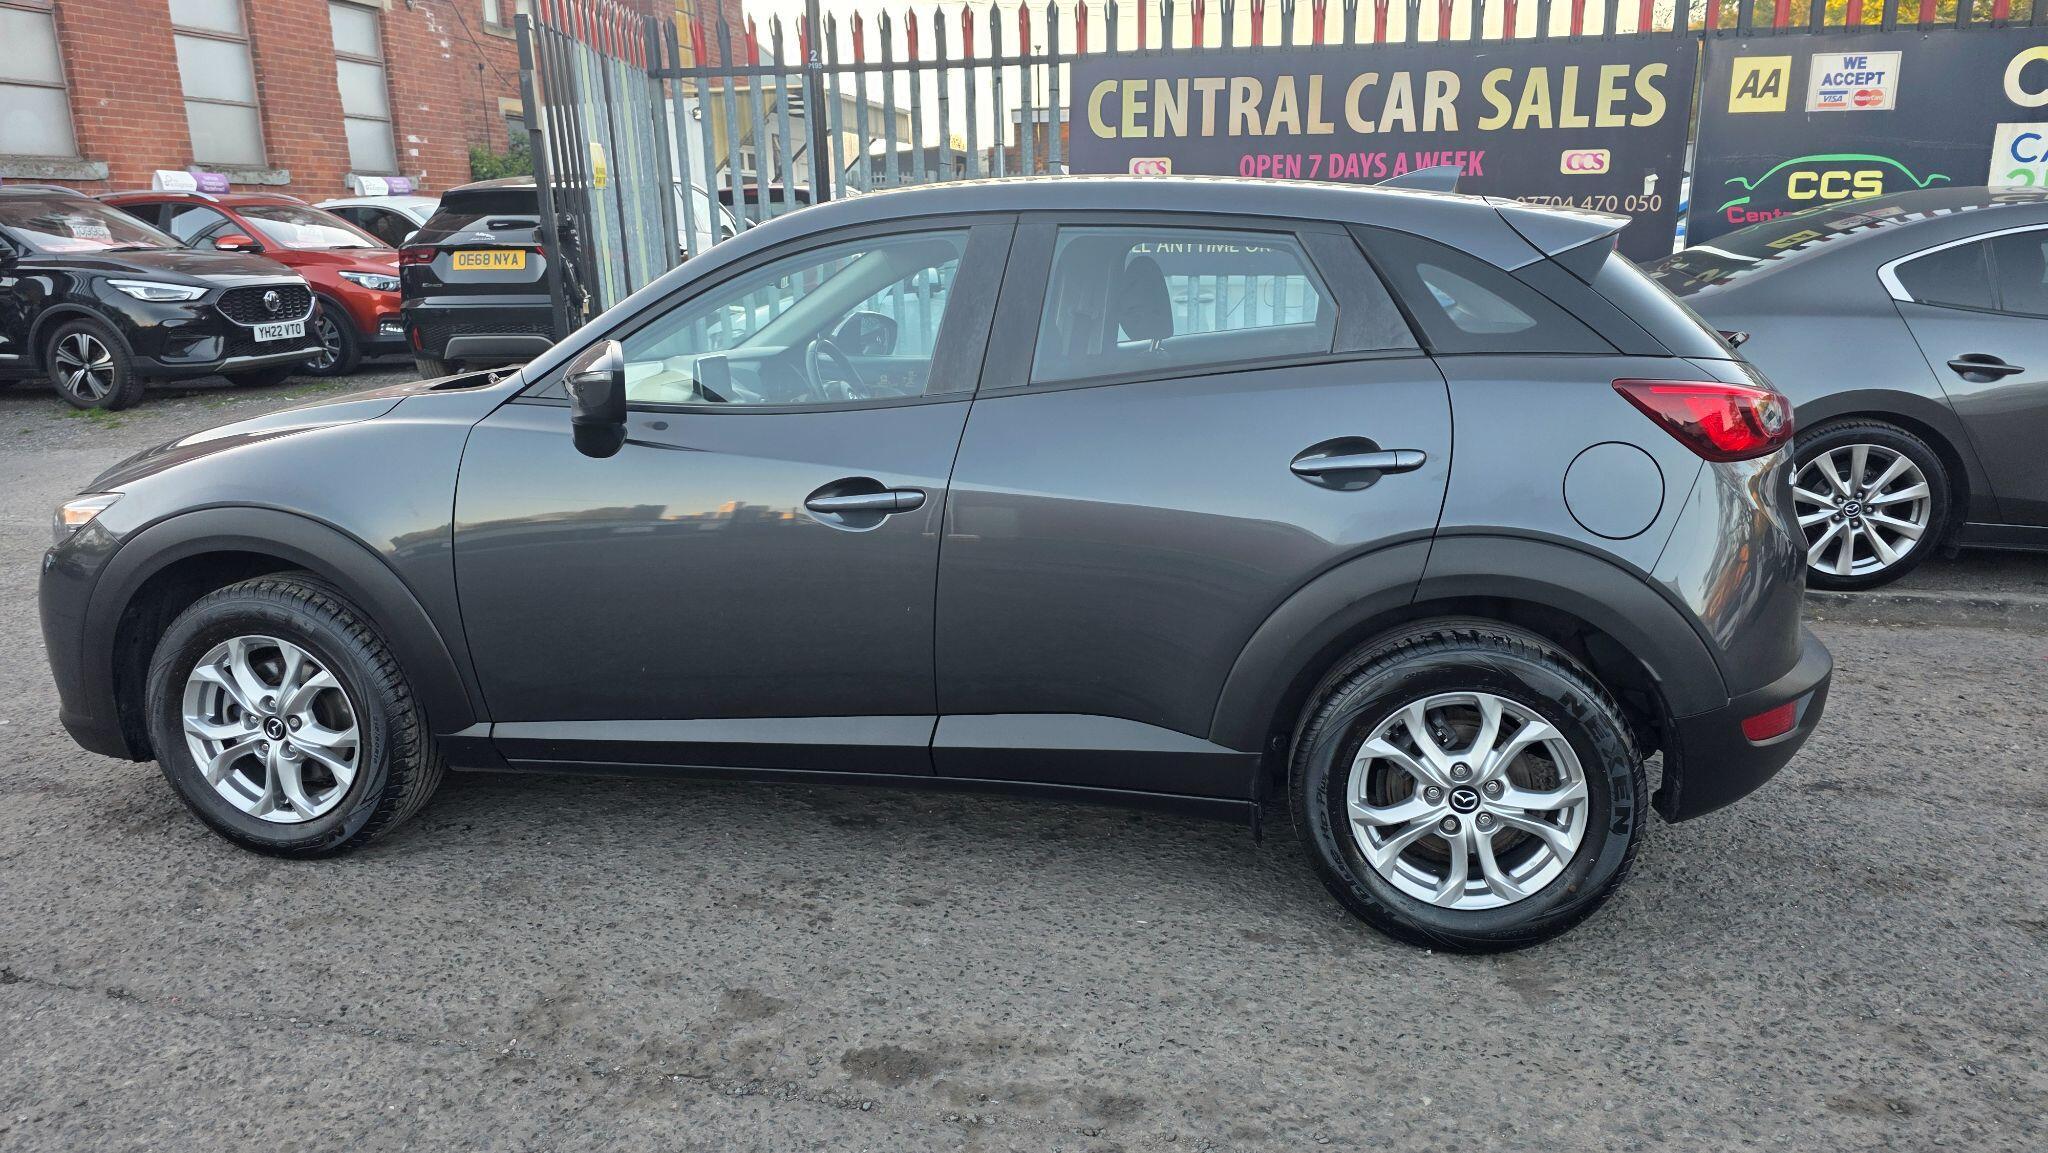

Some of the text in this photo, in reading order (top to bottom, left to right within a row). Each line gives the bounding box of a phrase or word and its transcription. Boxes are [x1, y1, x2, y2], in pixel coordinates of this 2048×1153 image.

[810, 50, 817, 61] 2
[1843, 56, 1867, 69] WE
[1735, 69, 1781, 99] AA
[1821, 72, 1885, 86] ACCEPT
[1088, 63, 1668, 138] CENTRAL CAR SALES
[1133, 160, 1167, 174] CCS
[1240, 151, 1486, 178] OPEN 7 DAYS A WEEK
[1566, 153, 1604, 170] CCS
[1787, 170, 1883, 200] CCS
[1581, 195, 1618, 212] 470
[1624, 194, 1662, 211] 050
[458, 252, 519, 266] OE68 NYA
[259, 326, 283, 338] YH22
[1558, 690, 1636, 834] NEXEN
